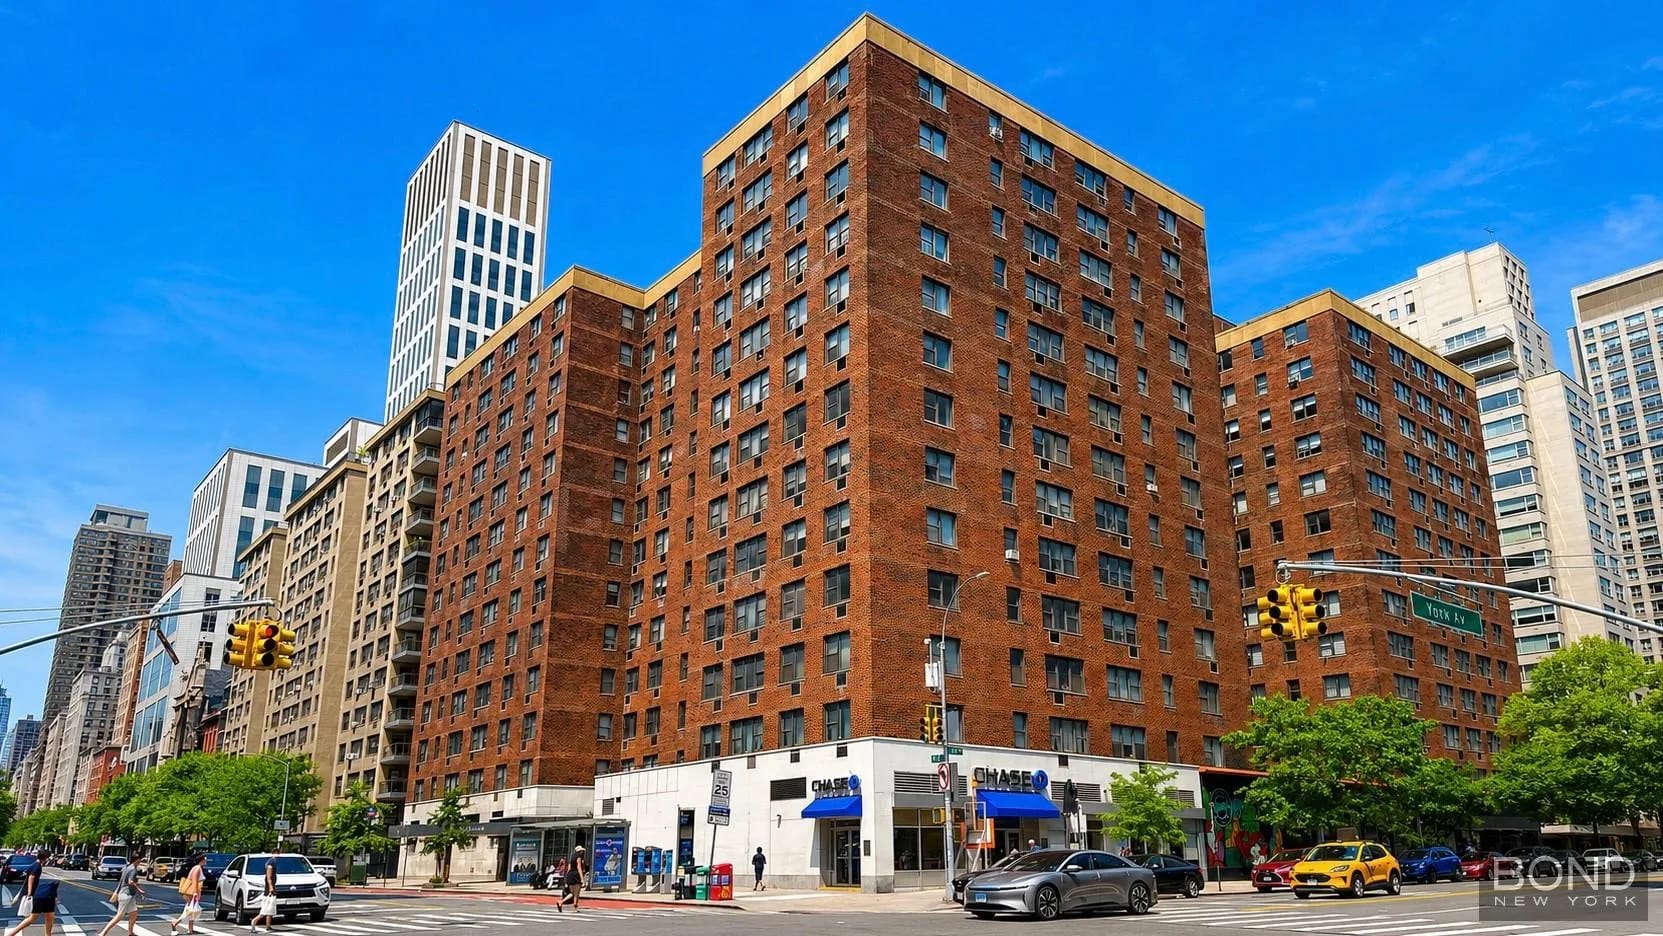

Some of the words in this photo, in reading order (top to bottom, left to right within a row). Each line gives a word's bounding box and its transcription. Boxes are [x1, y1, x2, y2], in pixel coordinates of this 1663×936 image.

[1426, 603, 1449, 621] York
[812, 777, 849, 793] CHASE
[974, 767, 1032, 787] CHASE
[714, 785, 729, 796] 25
